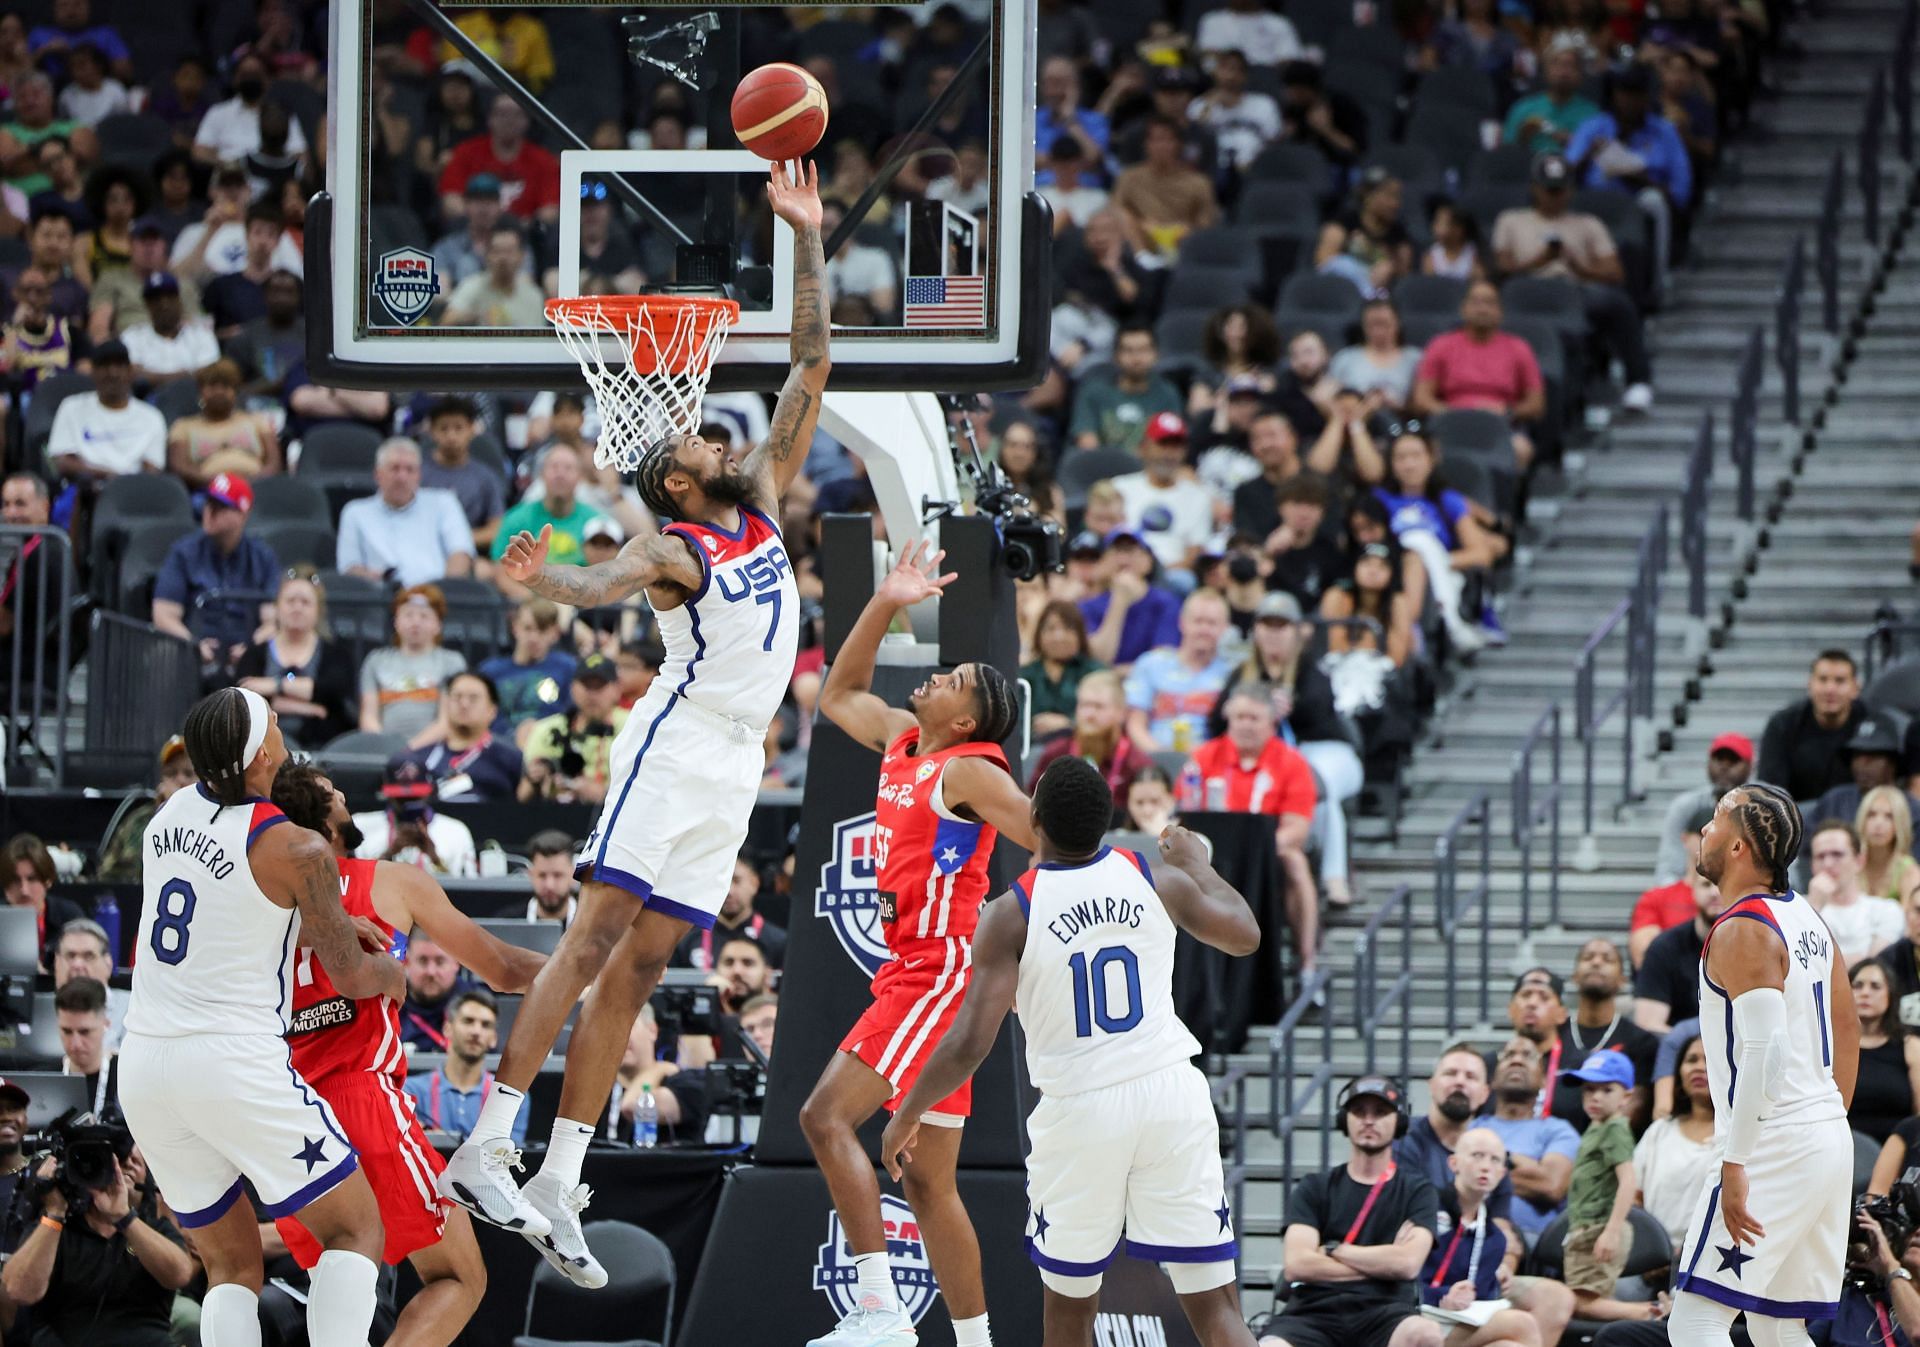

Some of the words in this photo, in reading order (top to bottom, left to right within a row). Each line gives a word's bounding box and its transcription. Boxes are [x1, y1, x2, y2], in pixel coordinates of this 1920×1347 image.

[388, 259, 429, 280] USA
[715, 545, 793, 603] USA
[755, 589, 782, 652] 7
[152, 827, 235, 880] BANCHERO
[874, 824, 893, 871] 55
[150, 877, 198, 966] 8
[1048, 897, 1145, 945] EDWARDS
[299, 1000, 346, 1021] SEGUROS
[1068, 945, 1144, 1038] 10
[294, 1009, 352, 1032] MULTIPLES
[823, 1271, 938, 1284] BASBALL
